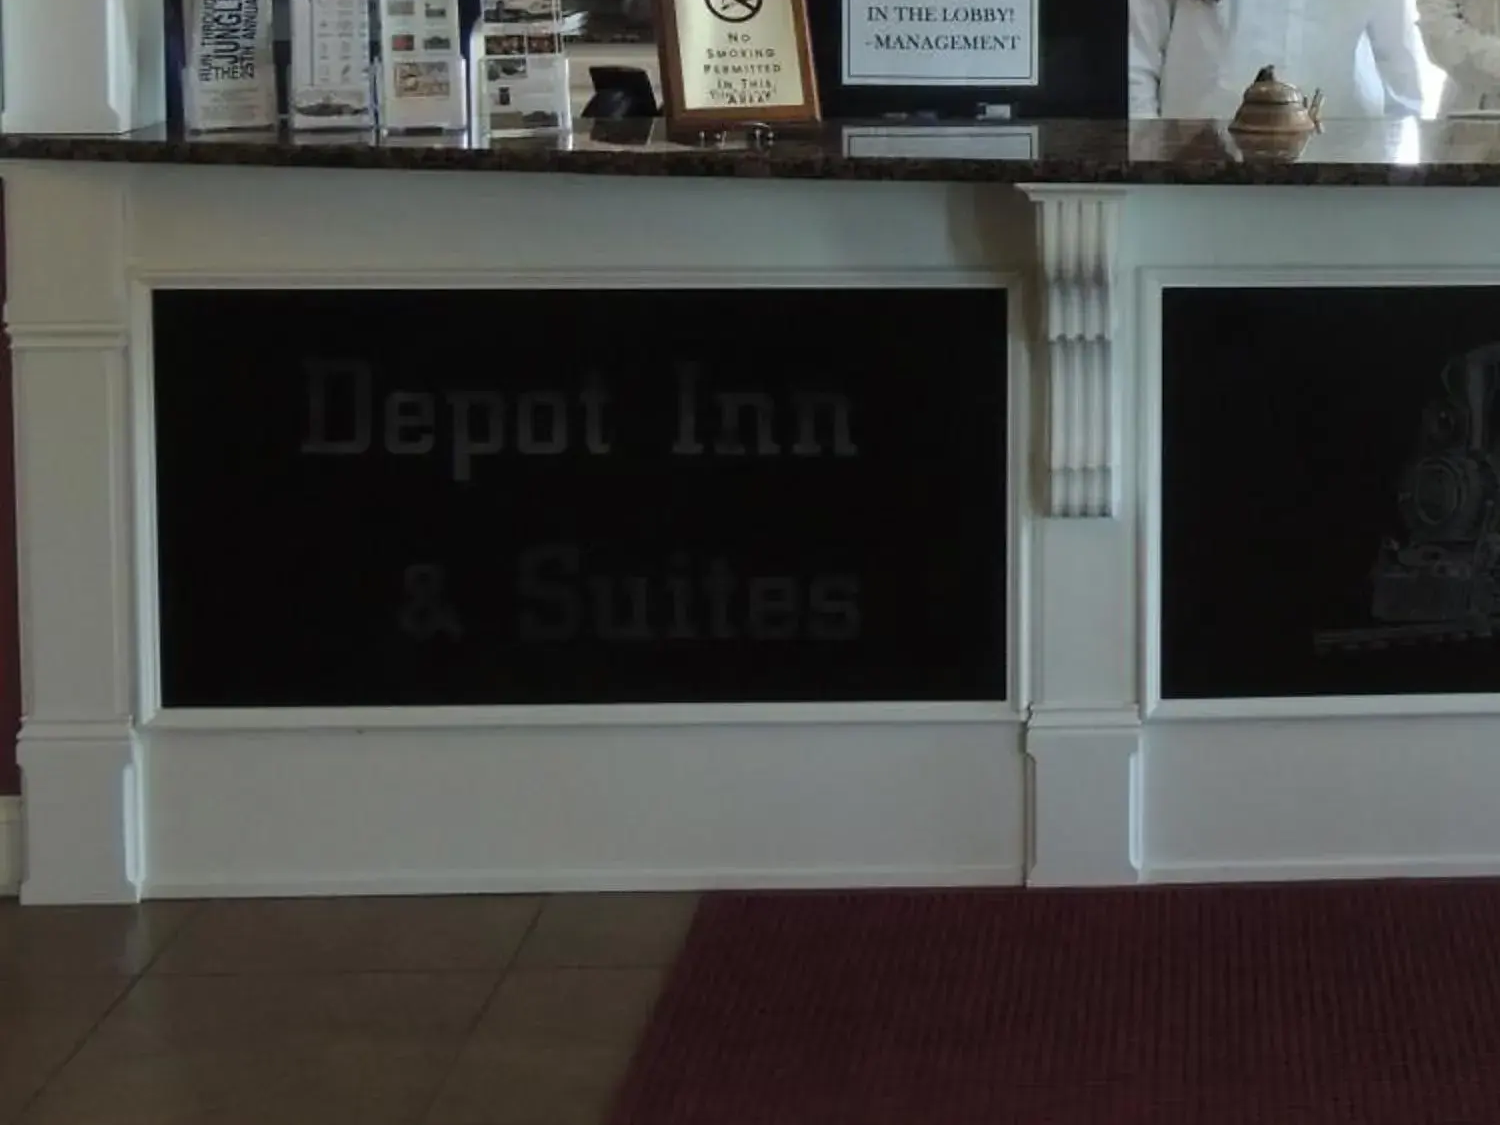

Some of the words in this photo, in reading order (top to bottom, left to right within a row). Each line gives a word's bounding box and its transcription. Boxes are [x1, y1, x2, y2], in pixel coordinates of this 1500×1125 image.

[867, 6, 888, 22] IN
[894, 6, 938, 22] THE
[727, 32, 752, 44] NO
[706, 47, 776, 59] SMOKING
[213, 66, 240, 81] THE
[703, 63, 781, 75] PERMITTED
[301, 357, 613, 483] Depot
[670, 360, 859, 457] Inn
[397, 563, 464, 643] &
[516, 541, 863, 643] Suites
